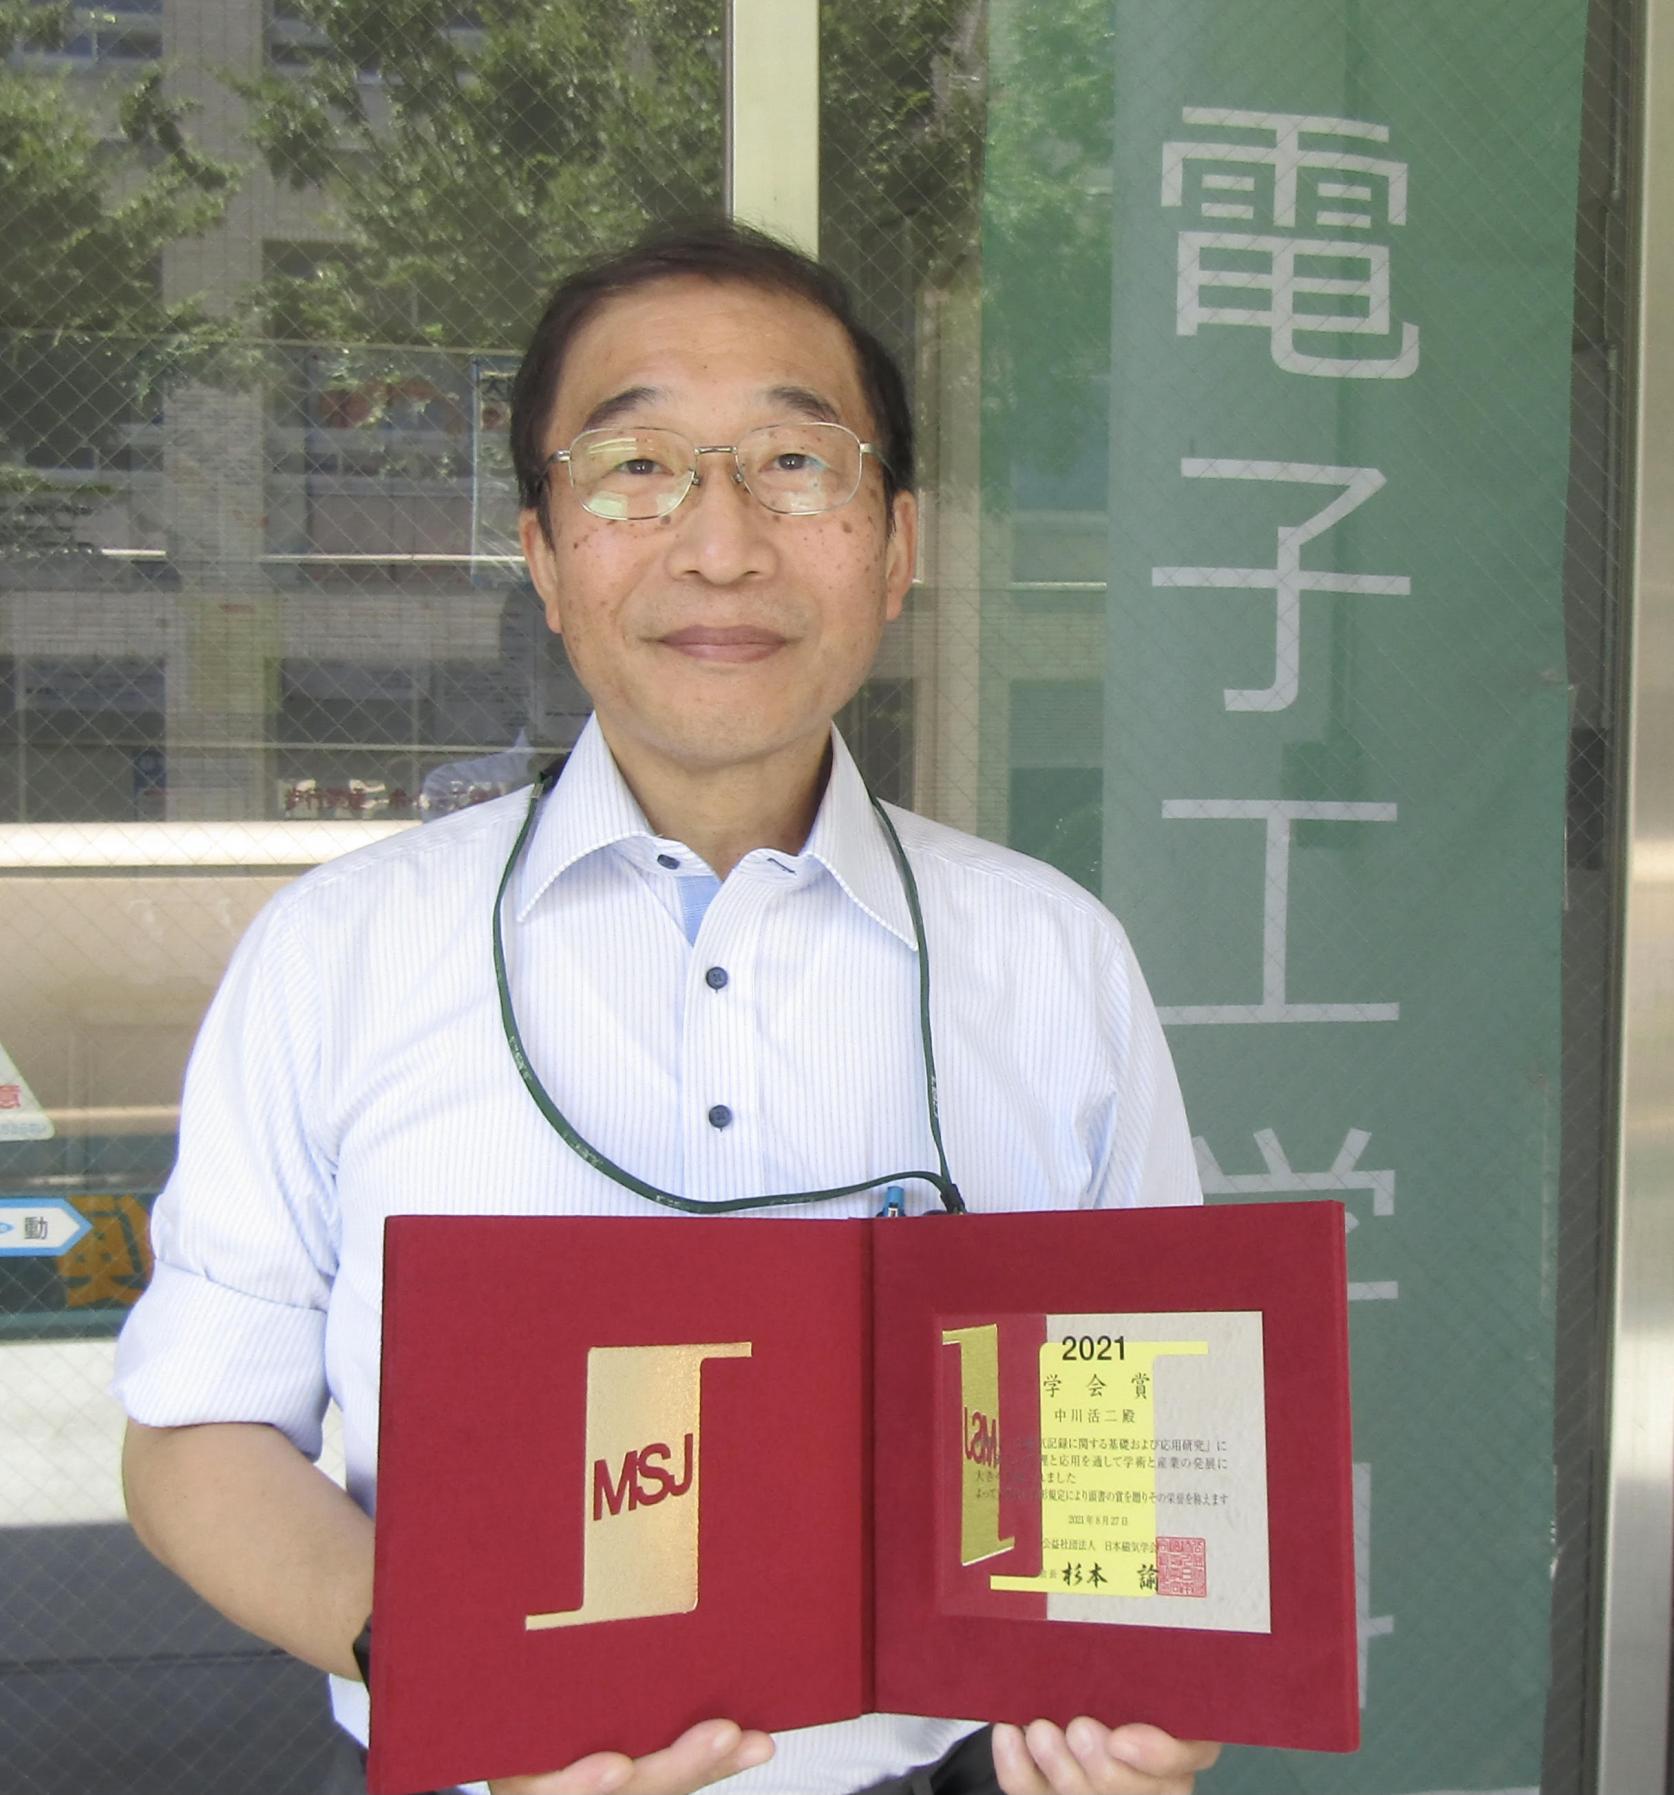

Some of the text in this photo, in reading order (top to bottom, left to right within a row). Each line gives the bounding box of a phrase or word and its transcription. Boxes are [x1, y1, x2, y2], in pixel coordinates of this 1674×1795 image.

[24, 1216, 48, 1240] 動
[1062, 1335, 1125, 1361] 2021
[1054, 1408, 1136, 1424] 中川活二殿
[593, 1433, 694, 1521] MSJ
